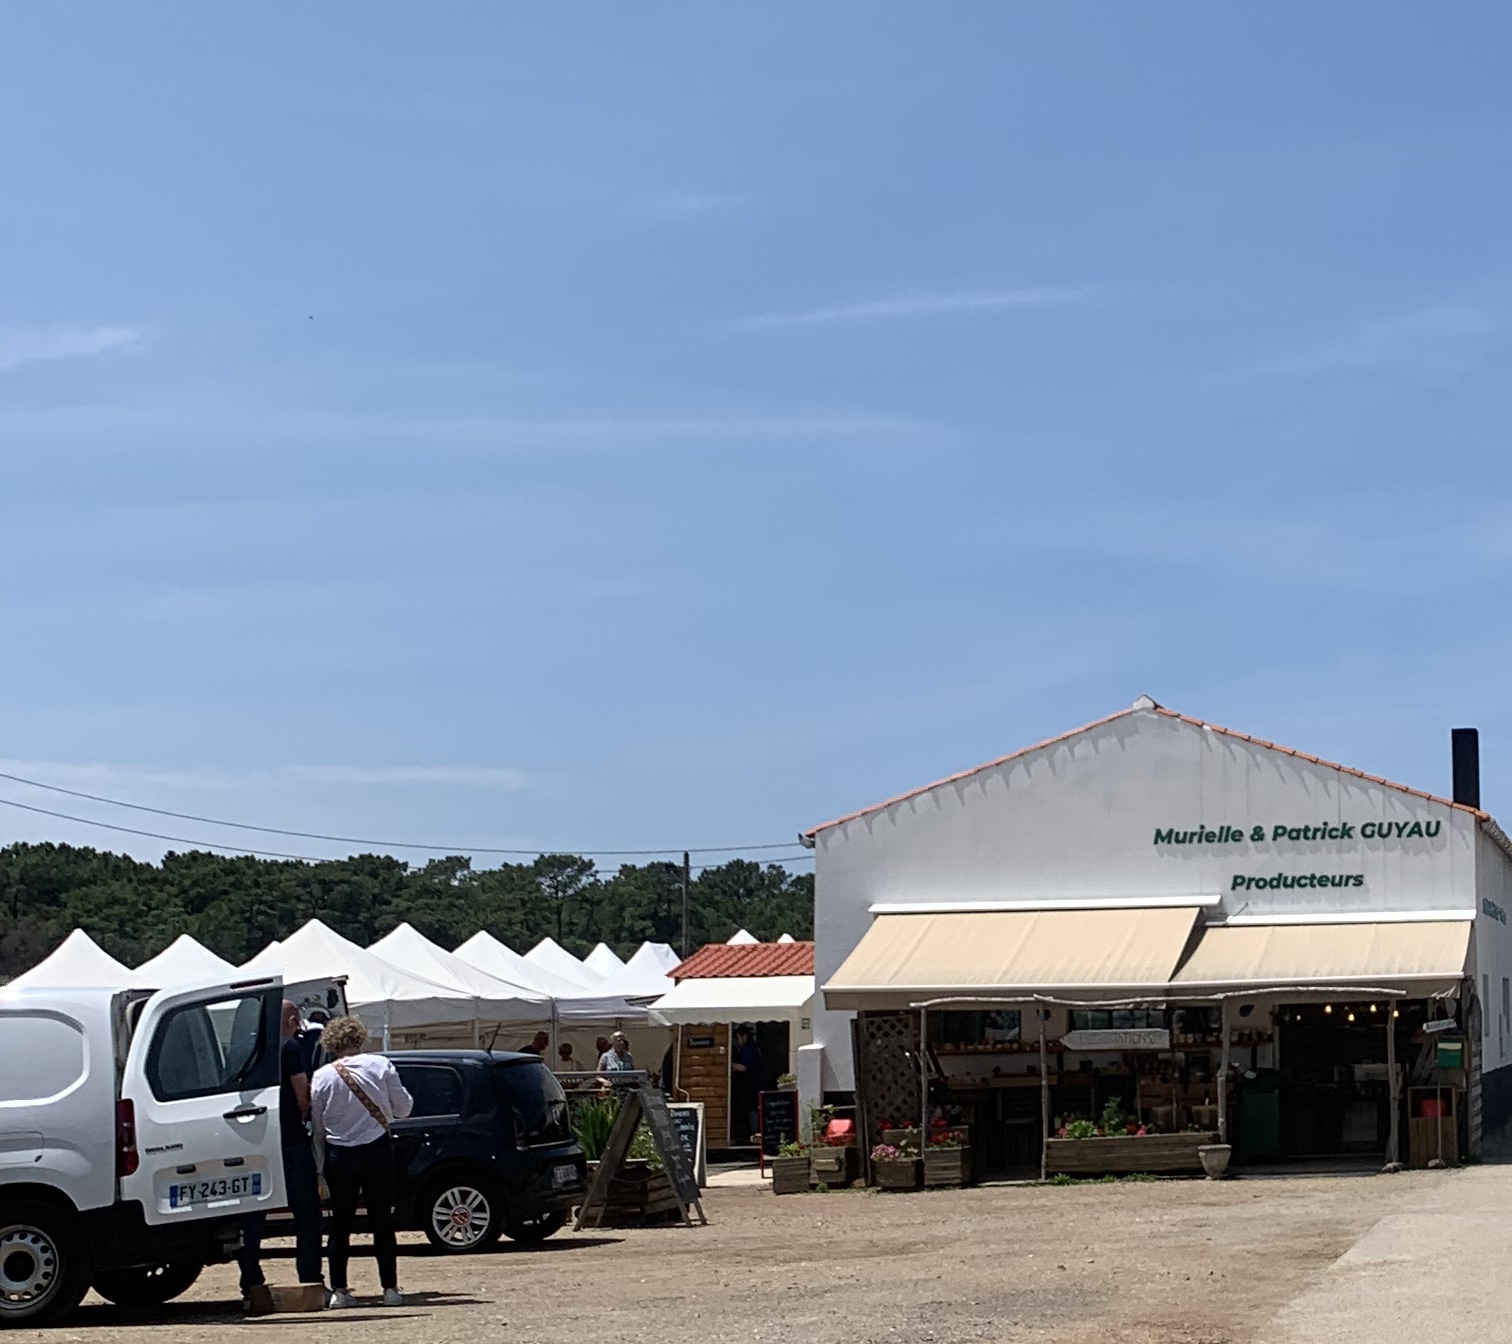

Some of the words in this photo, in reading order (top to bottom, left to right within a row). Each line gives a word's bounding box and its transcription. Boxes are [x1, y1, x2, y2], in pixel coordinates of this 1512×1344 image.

[1153, 825, 1244, 844] Murielle
[1250, 825, 1265, 842] &
[1272, 821, 1355, 842] Patrick
[1360, 820, 1441, 838] GUYAU
[1231, 873, 1364, 891] Producteurs
